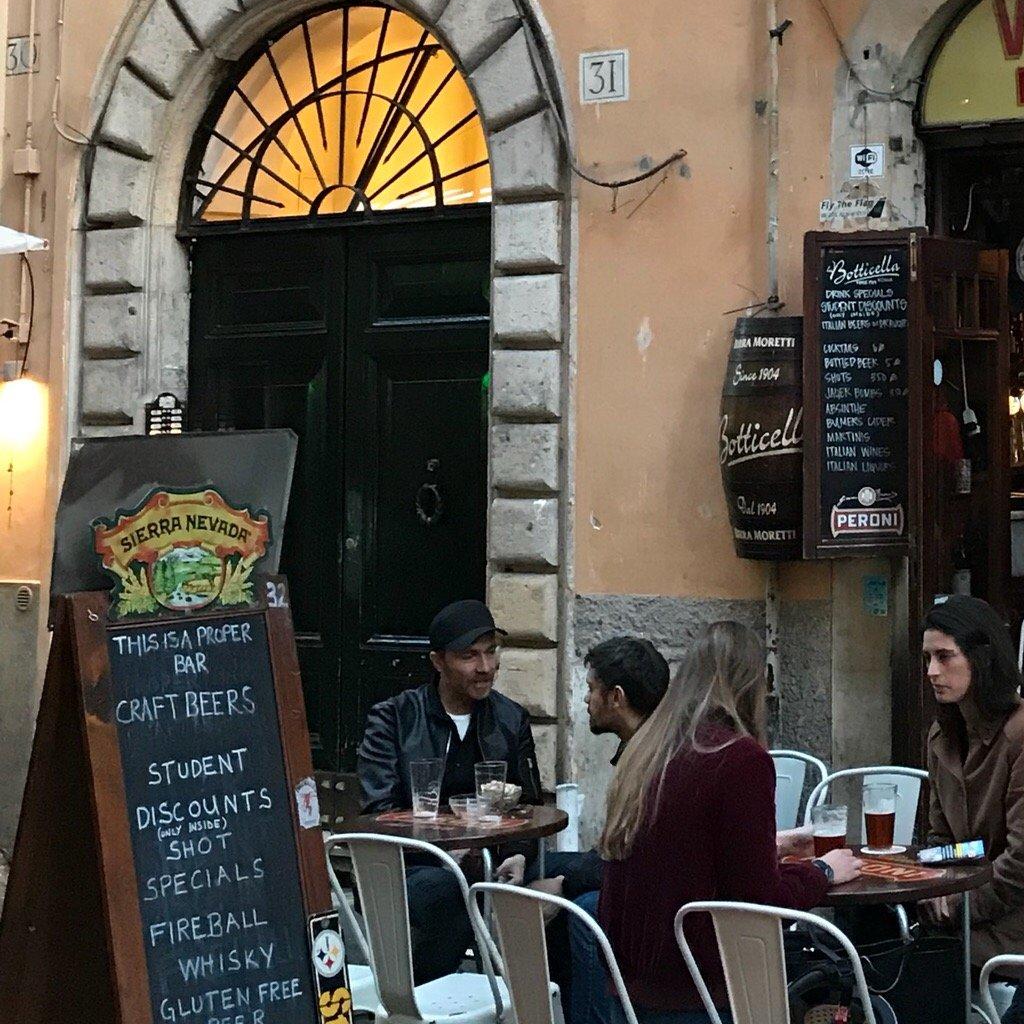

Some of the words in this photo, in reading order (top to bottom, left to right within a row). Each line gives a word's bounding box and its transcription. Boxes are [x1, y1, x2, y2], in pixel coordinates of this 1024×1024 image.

[589, 60, 616, 94] 31
[837, 200, 852, 208] The
[753, 337, 796, 347] MORETTI
[759, 367, 780, 380] 1904
[757, 502, 777, 516] 1904
[837, 512, 898, 528] PERONI
[120, 516, 182, 553] SIERRA
[186, 514, 250, 543] NEVADA
[754, 530, 796, 541] MORETTI
[266, 581, 290, 607] 32
[112, 633, 159, 656] THIS
[197, 623, 252, 647] PROPER
[174, 652, 209, 674] BAR
[116, 694, 179, 724] CRAFT
[185, 686, 256, 718] BEERS
[149, 748, 248, 785] STUDENT
[136, 788, 272, 830] DISCOUNTS
[157, 826, 182, 841] (ONLY
[188, 817, 227, 833] INSIDE)
[167, 832, 232, 860] SHOT
[143, 858, 264, 901] SPECIALS
[150, 909, 268, 947] FIREBALL
[178, 942, 274, 981] WHISKY
[160, 987, 250, 1022] GLUTEN
[258, 978, 303, 1003] FREE
